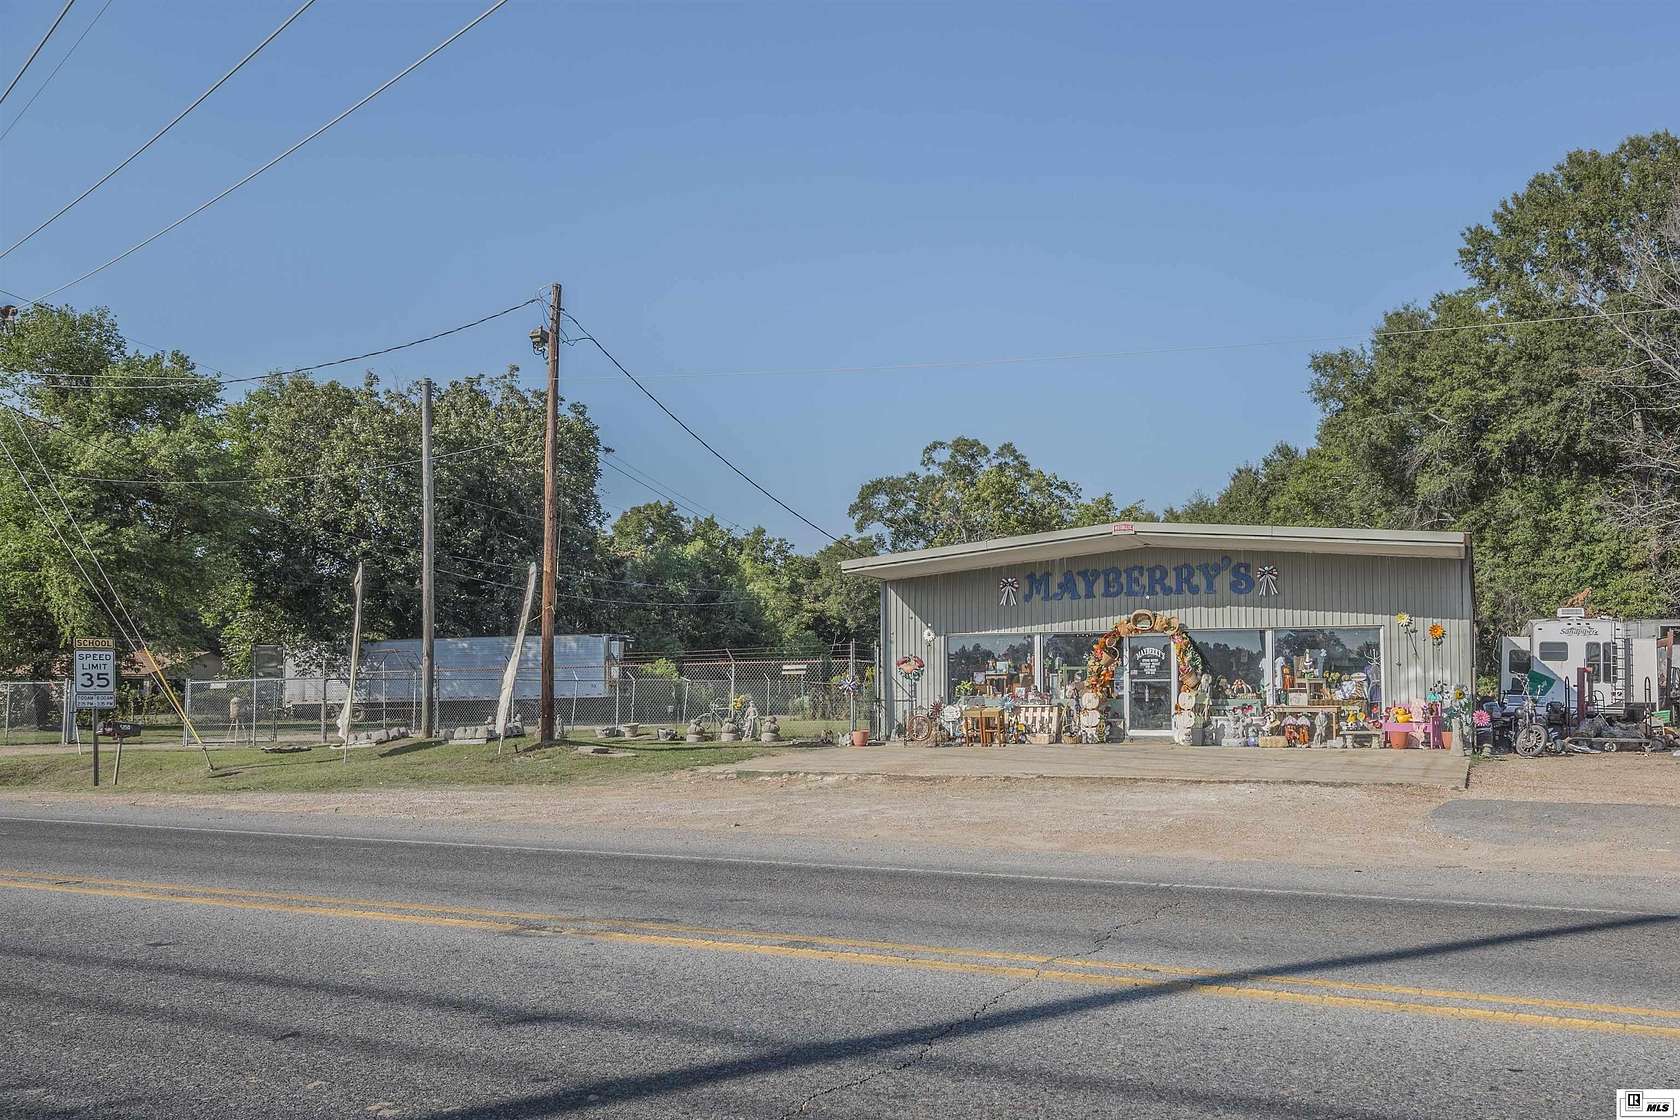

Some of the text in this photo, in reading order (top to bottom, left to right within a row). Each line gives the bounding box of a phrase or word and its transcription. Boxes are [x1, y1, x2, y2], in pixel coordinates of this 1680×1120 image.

[1023, 555, 1256, 604] MAYBERRY'S
[77, 639, 112, 647] SCHOOL
[78, 653, 112, 661] SPEED
[80, 673, 110, 688] 35
